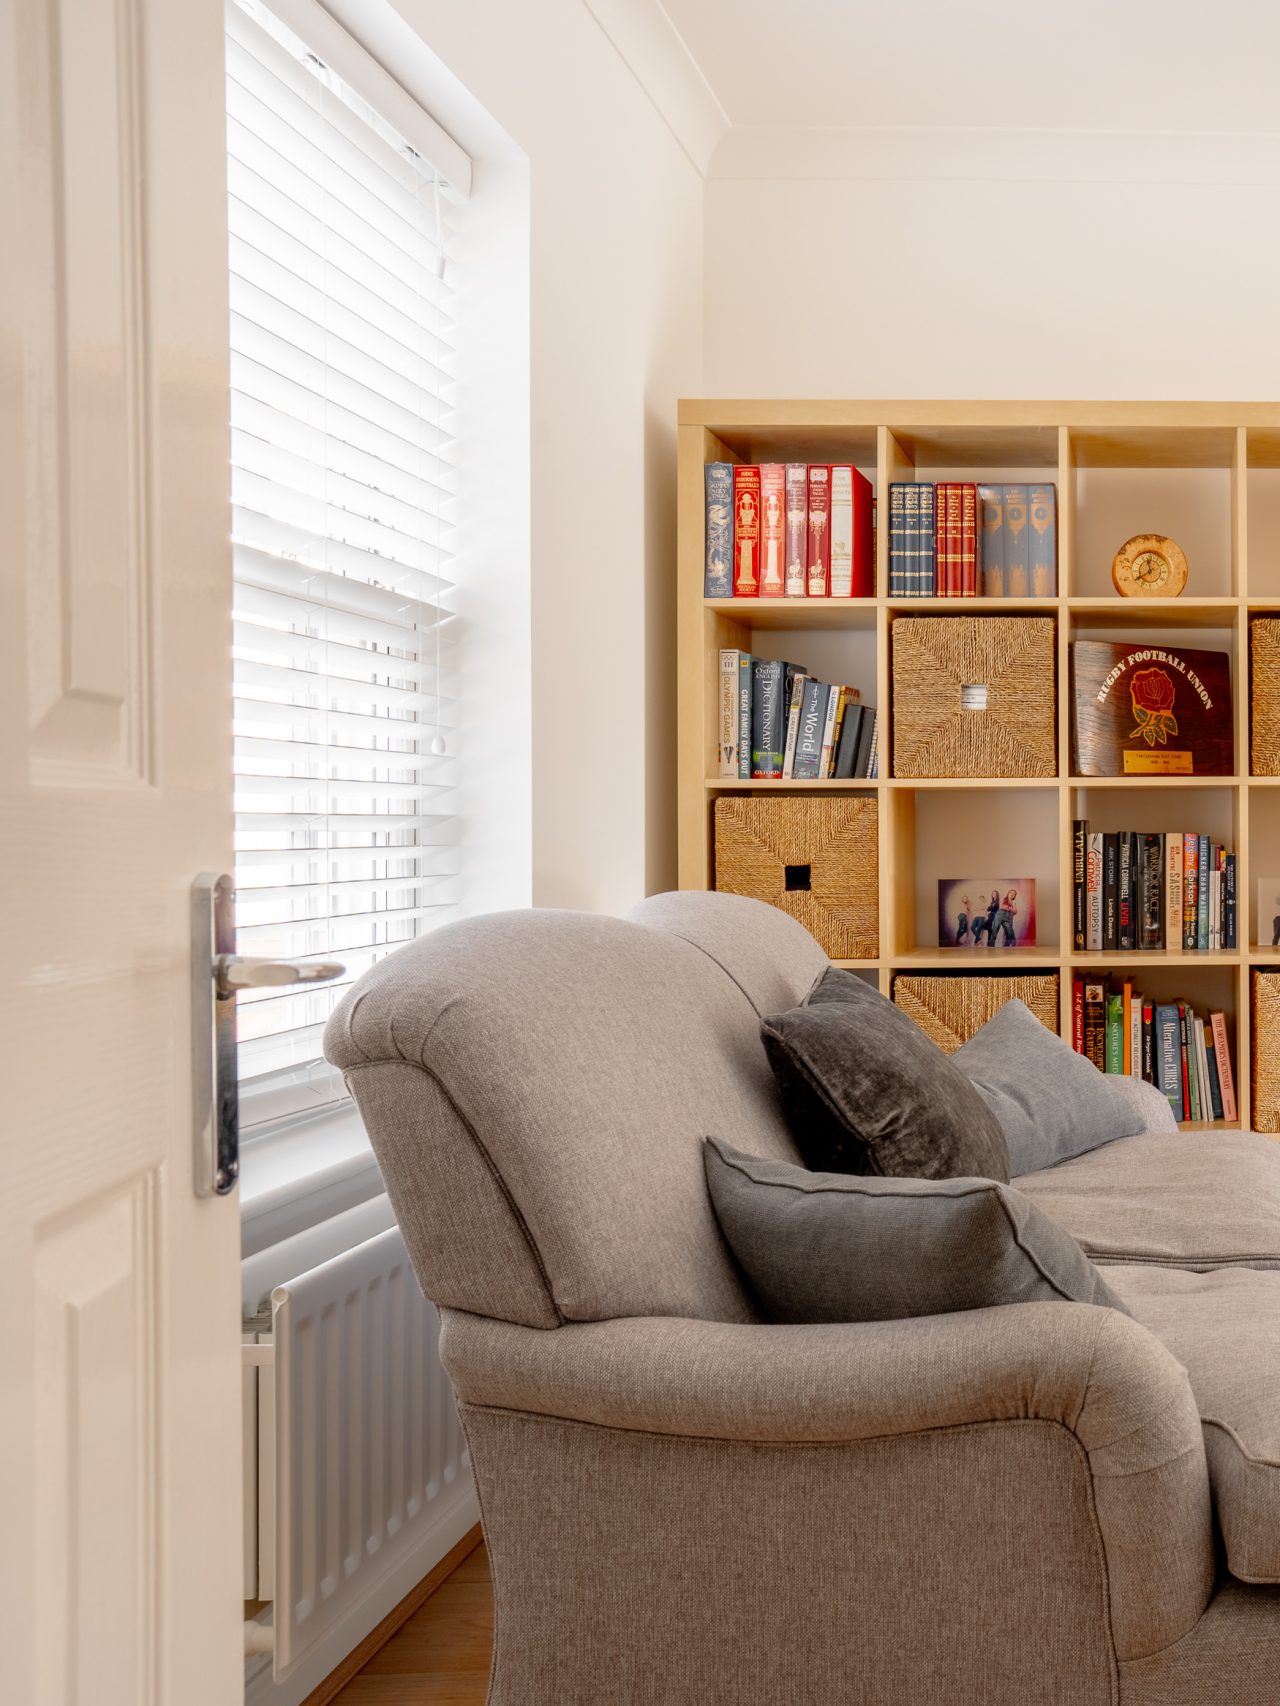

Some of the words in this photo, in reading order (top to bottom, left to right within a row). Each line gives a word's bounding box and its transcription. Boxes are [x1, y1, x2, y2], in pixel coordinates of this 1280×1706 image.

[723, 677, 731, 712] OLYMPIC
[1097, 660, 1127, 704] RUGBY
[1126, 650, 1185, 673] FOOTBALL
[1186, 670, 1213, 710] UNION
[762, 680, 773, 751] DICTIONARY
[803, 713, 818, 752] World
[1076, 831, 1084, 883] UMBULALA
[1088, 851, 1096, 893] Cornwell
[1121, 845, 1129, 868] PATRICIA
[1151, 846, 1159, 887] WARRIOR
[1121, 869, 1129, 899] CORNWELL
[1151, 889, 1159, 911] RACE
[1170, 873, 1180, 890] SAS
[1120, 902, 1129, 926] LIVID
[1162, 1022, 1175, 1062] Alternative
[1165, 1064, 1178, 1089] CURES
